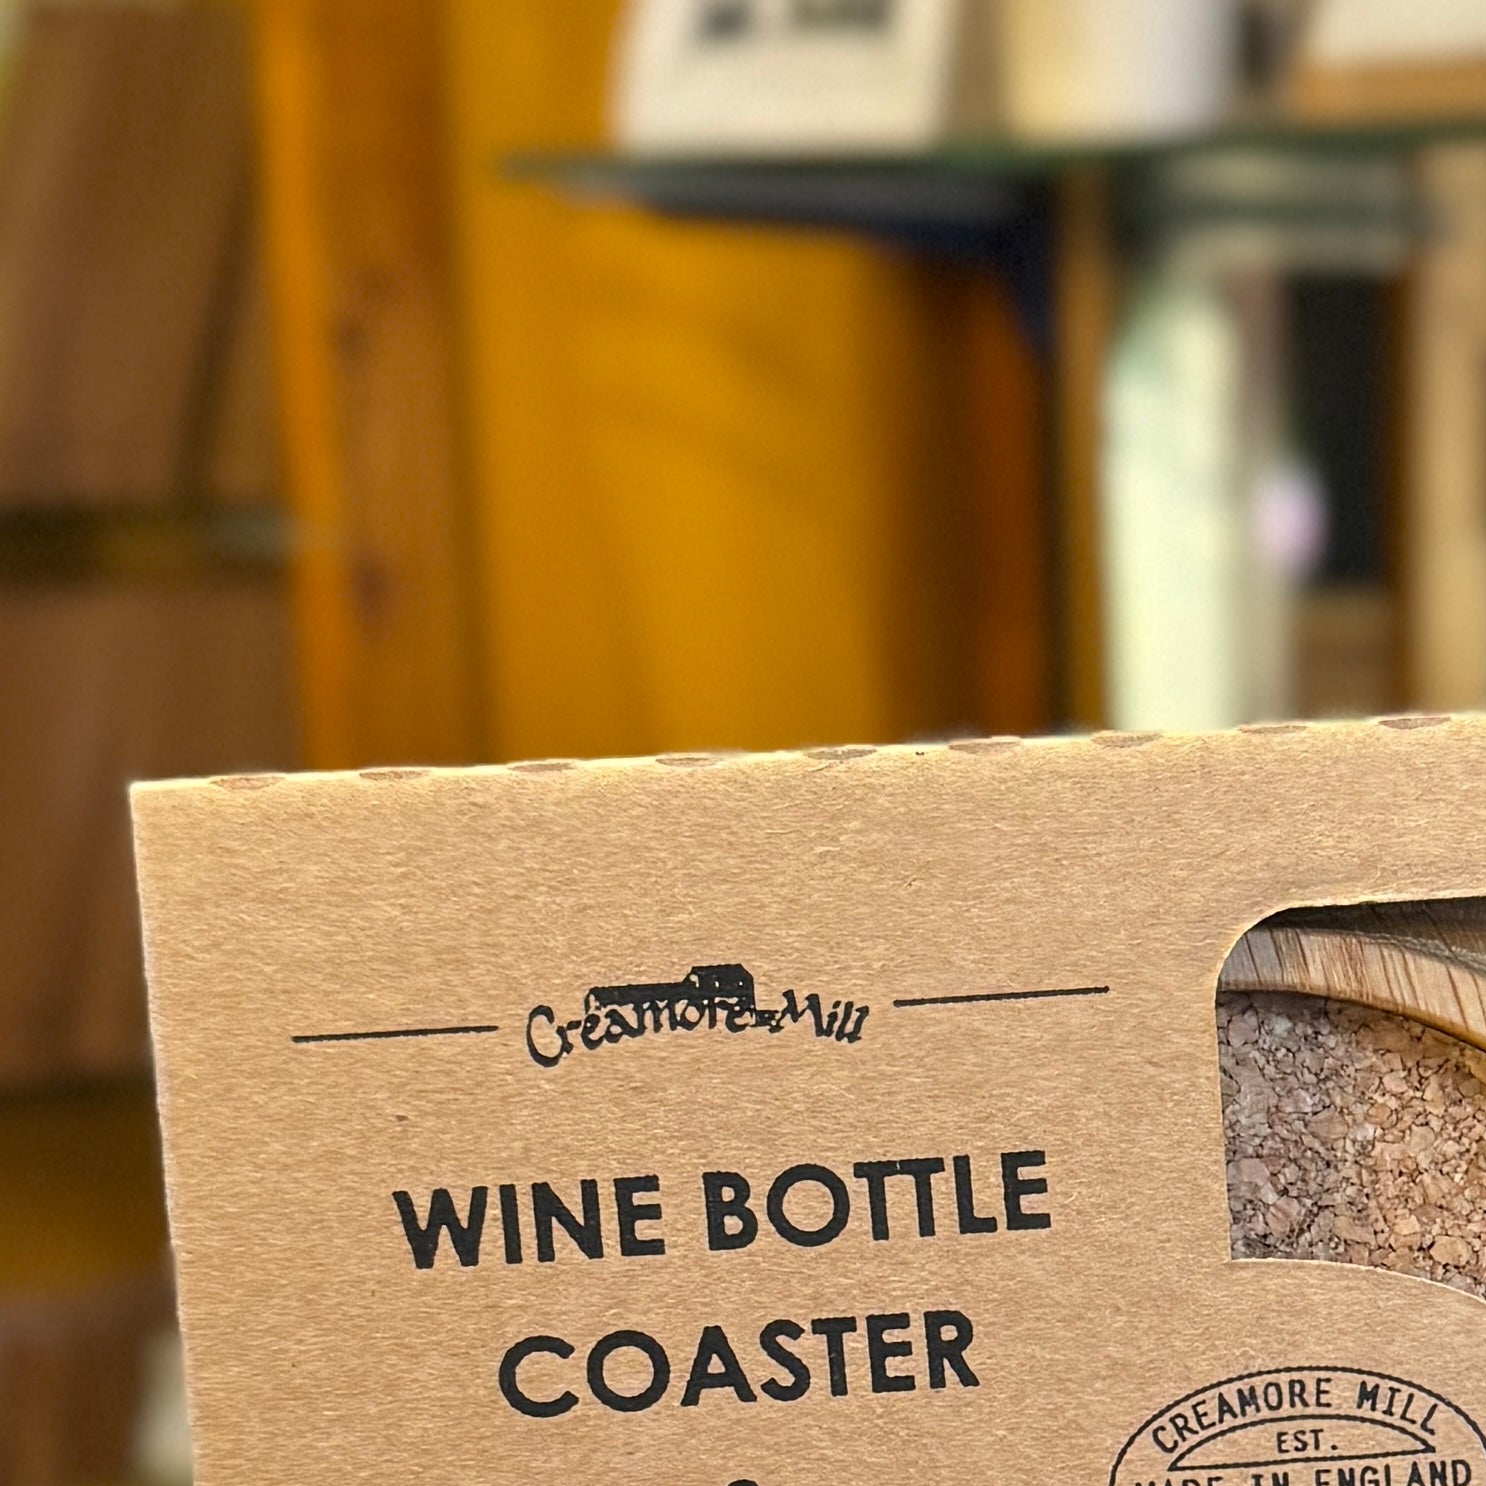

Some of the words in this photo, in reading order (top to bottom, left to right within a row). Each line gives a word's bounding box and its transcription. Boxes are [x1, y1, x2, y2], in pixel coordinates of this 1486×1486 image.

[526, 996, 755, 1068] Creamore
[772, 989, 870, 1044] Mill
[391, 1174, 666, 1270] WINE
[701, 1149, 1052, 1251] BOTTLE
[498, 1309, 980, 1418] COASTER
[1152, 1377, 1333, 1454] CREAMORE
[1356, 1380, 1438, 1436] MILL
[1276, 1428, 1338, 1454] EST.
